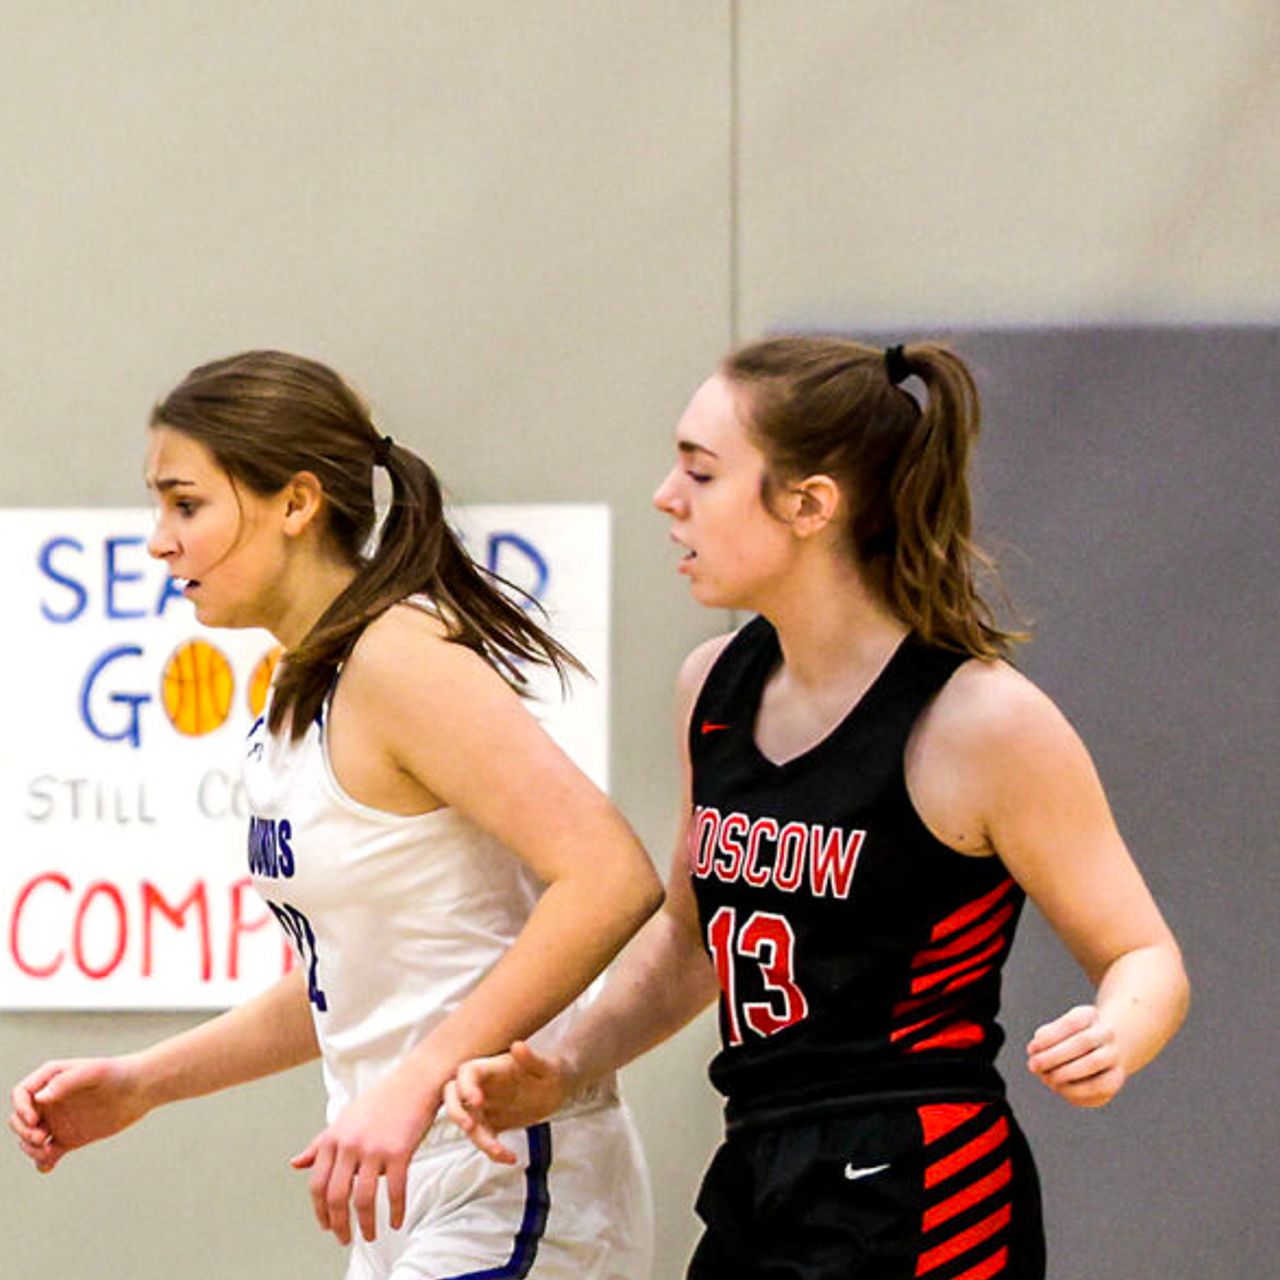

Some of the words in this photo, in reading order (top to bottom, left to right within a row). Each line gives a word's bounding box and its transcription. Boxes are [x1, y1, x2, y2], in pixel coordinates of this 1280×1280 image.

[25, 773, 158, 825] STILL
[688, 805, 867, 899] OSCOW
[8, 870, 293, 981] COMP
[707, 905, 809, 1047] 13
